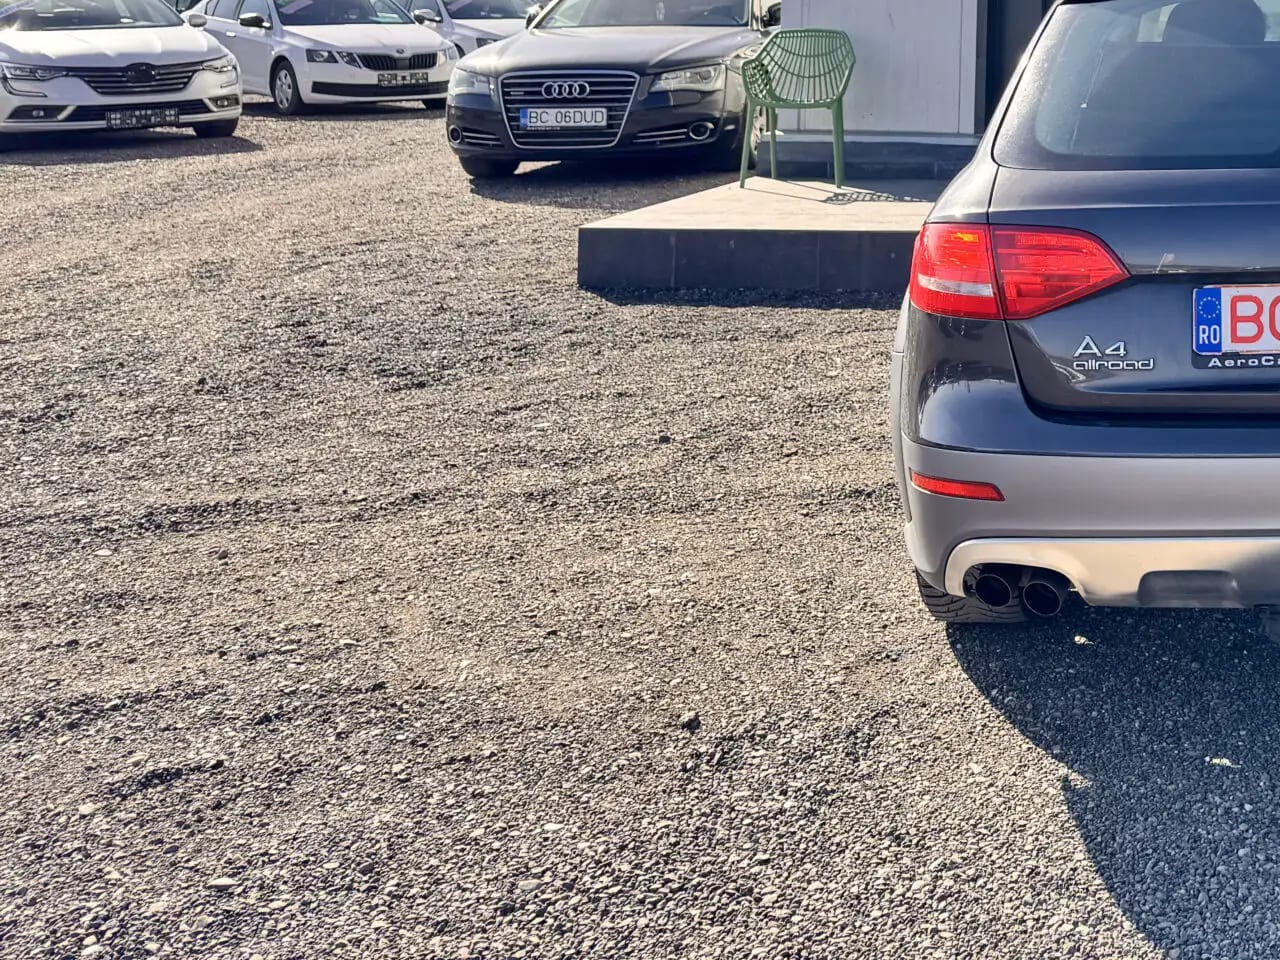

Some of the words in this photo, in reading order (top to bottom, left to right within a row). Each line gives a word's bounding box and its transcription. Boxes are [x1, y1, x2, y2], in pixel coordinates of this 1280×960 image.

[529, 111, 549, 124] BC
[555, 110, 604, 124] 06DUD
[1199, 324, 1220, 345] RO
[1073, 335, 1127, 358] A4
[1073, 358, 1154, 371] allroad
